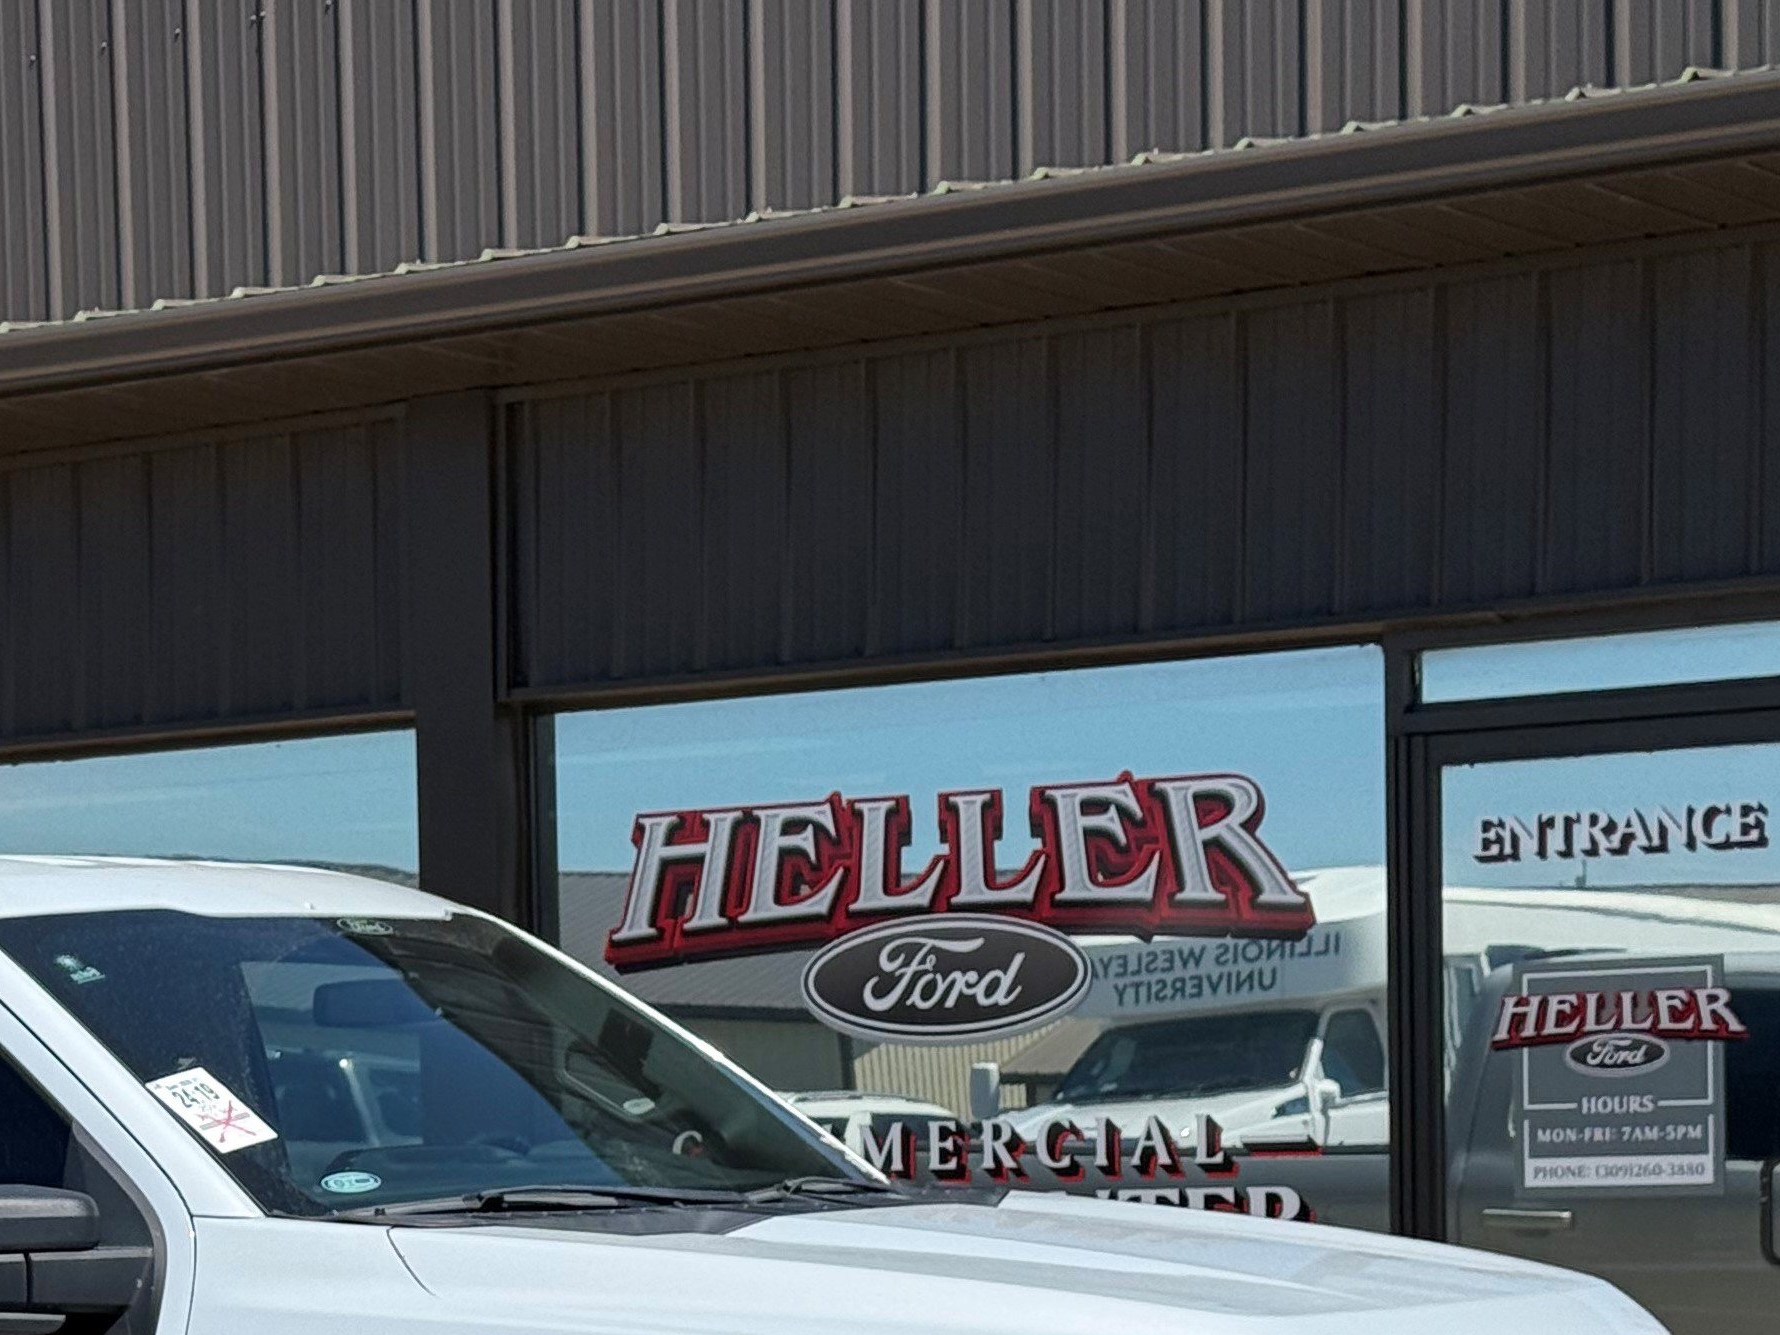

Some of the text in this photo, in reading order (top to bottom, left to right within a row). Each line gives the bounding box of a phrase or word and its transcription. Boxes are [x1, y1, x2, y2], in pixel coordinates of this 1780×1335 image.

[1473, 803, 1769, 863] ENTRANCE
[608, 771, 1314, 960] HELLER
[863, 936, 1026, 1012] Ford
[1493, 987, 1749, 1049] HELLER
[1585, 1038, 1646, 1067] Ford
[1581, 1095, 1655, 1115] HOURS
[1621, 1123, 1702, 1142] 7AM-5PM
[1533, 1164, 1593, 1180] PHONE:
